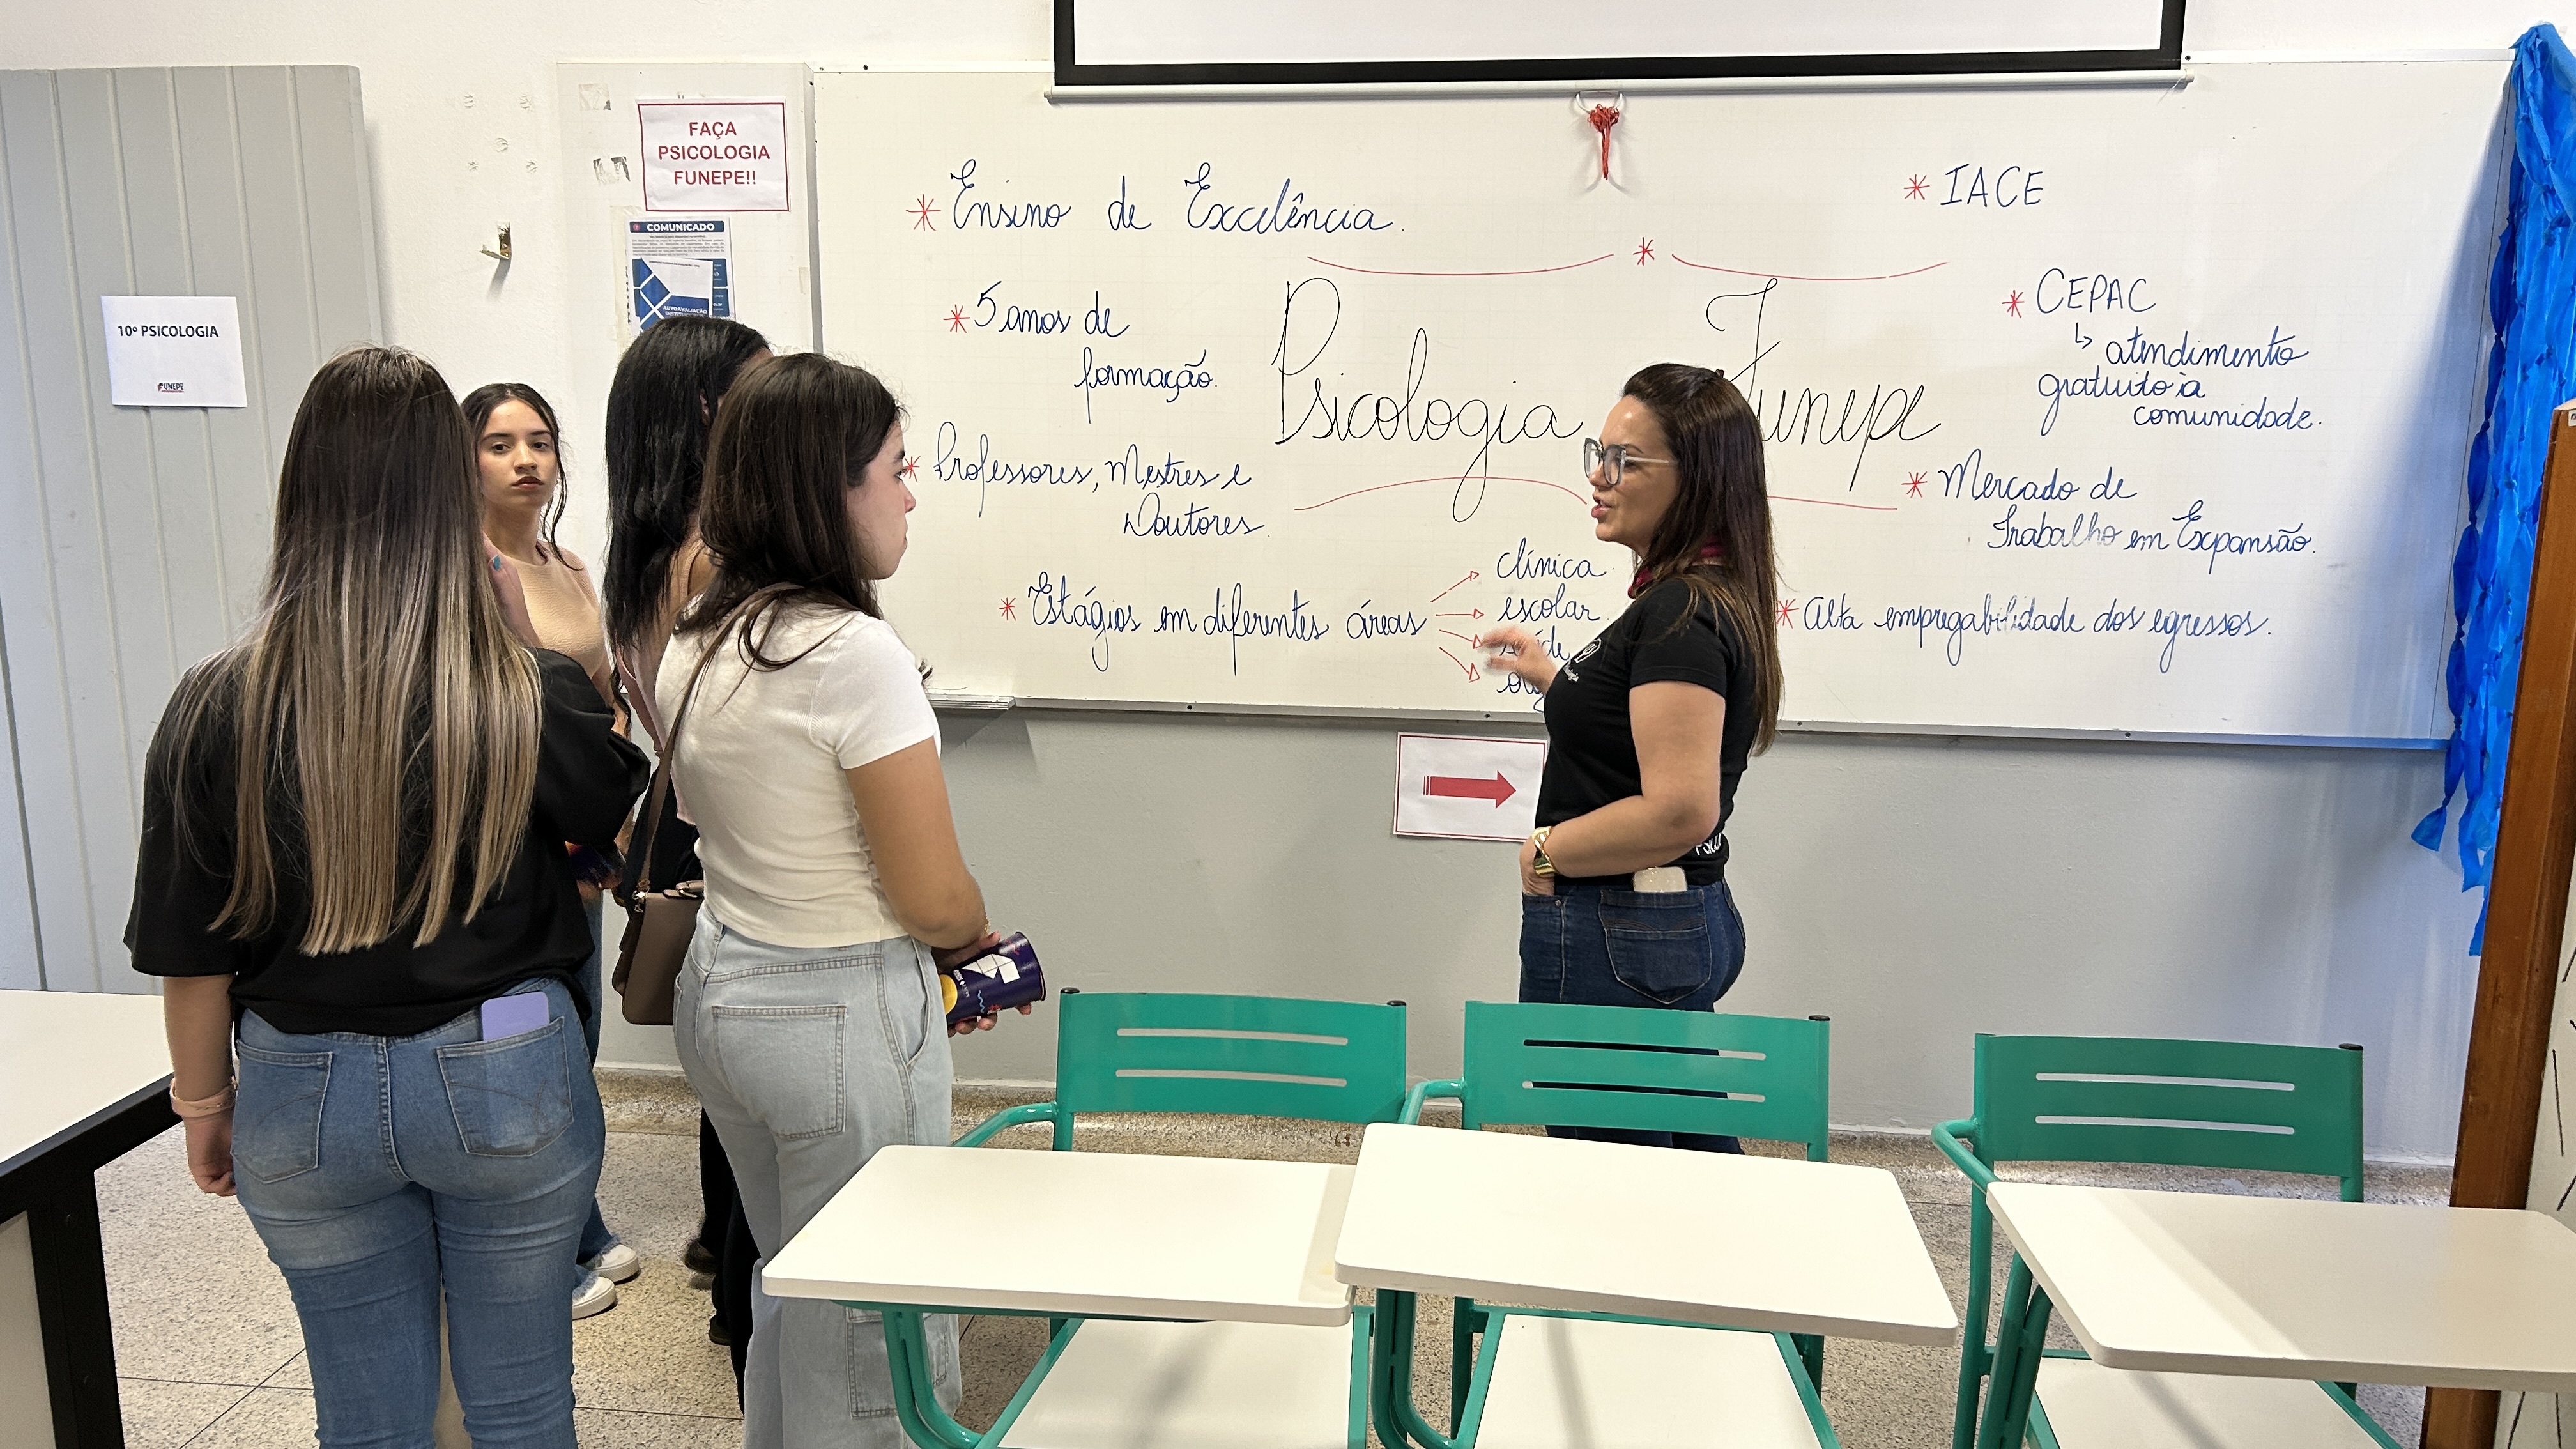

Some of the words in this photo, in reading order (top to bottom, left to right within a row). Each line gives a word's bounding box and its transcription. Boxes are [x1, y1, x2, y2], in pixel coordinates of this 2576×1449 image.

[659, 145, 770, 160] PSICOLOGIA
[689, 121, 737, 140] FAÇA
[674, 170, 756, 185] FUNEPE!!
[950, 159, 1071, 229] Ensino
[1108, 176, 1152, 229] de
[1940, 164, 2044, 208] IACE
[647, 223, 715, 232] COMUNICADO
[974, 281, 1002, 327] 5
[999, 308, 1071, 335] anos
[1085, 291, 1130, 337] de
[2037, 268, 2156, 314] CEPAC
[118, 325, 138, 337] 10º
[141, 325, 219, 337] PSICOLOGIA
[2106, 325, 2309, 367] atendimento
[157, 383, 184, 392] FUNEPE
[1272, 277, 1583, 523] Psicologia
[1706, 278, 1941, 492] Funepe
[2038, 365, 2174, 436] gratuito
[1105, 444, 1220, 489] Mestres
[1221, 464, 1252, 489] e
[1938, 448, 2080, 501] Mercado
[2090, 466, 2137, 500] de
[1987, 503, 2123, 549] Trabalho
[2124, 530, 2169, 551] em
[1027, 571, 1142, 673] Estágios
[1154, 607, 1198, 633] em
[1204, 582, 1329, 676] diferentes
[1347, 599, 1427, 639] áreas
[1804, 594, 1863, 629] Alta
[1874, 593, 2085, 666] empregabilidade
[2094, 600, 2145, 631] dos
